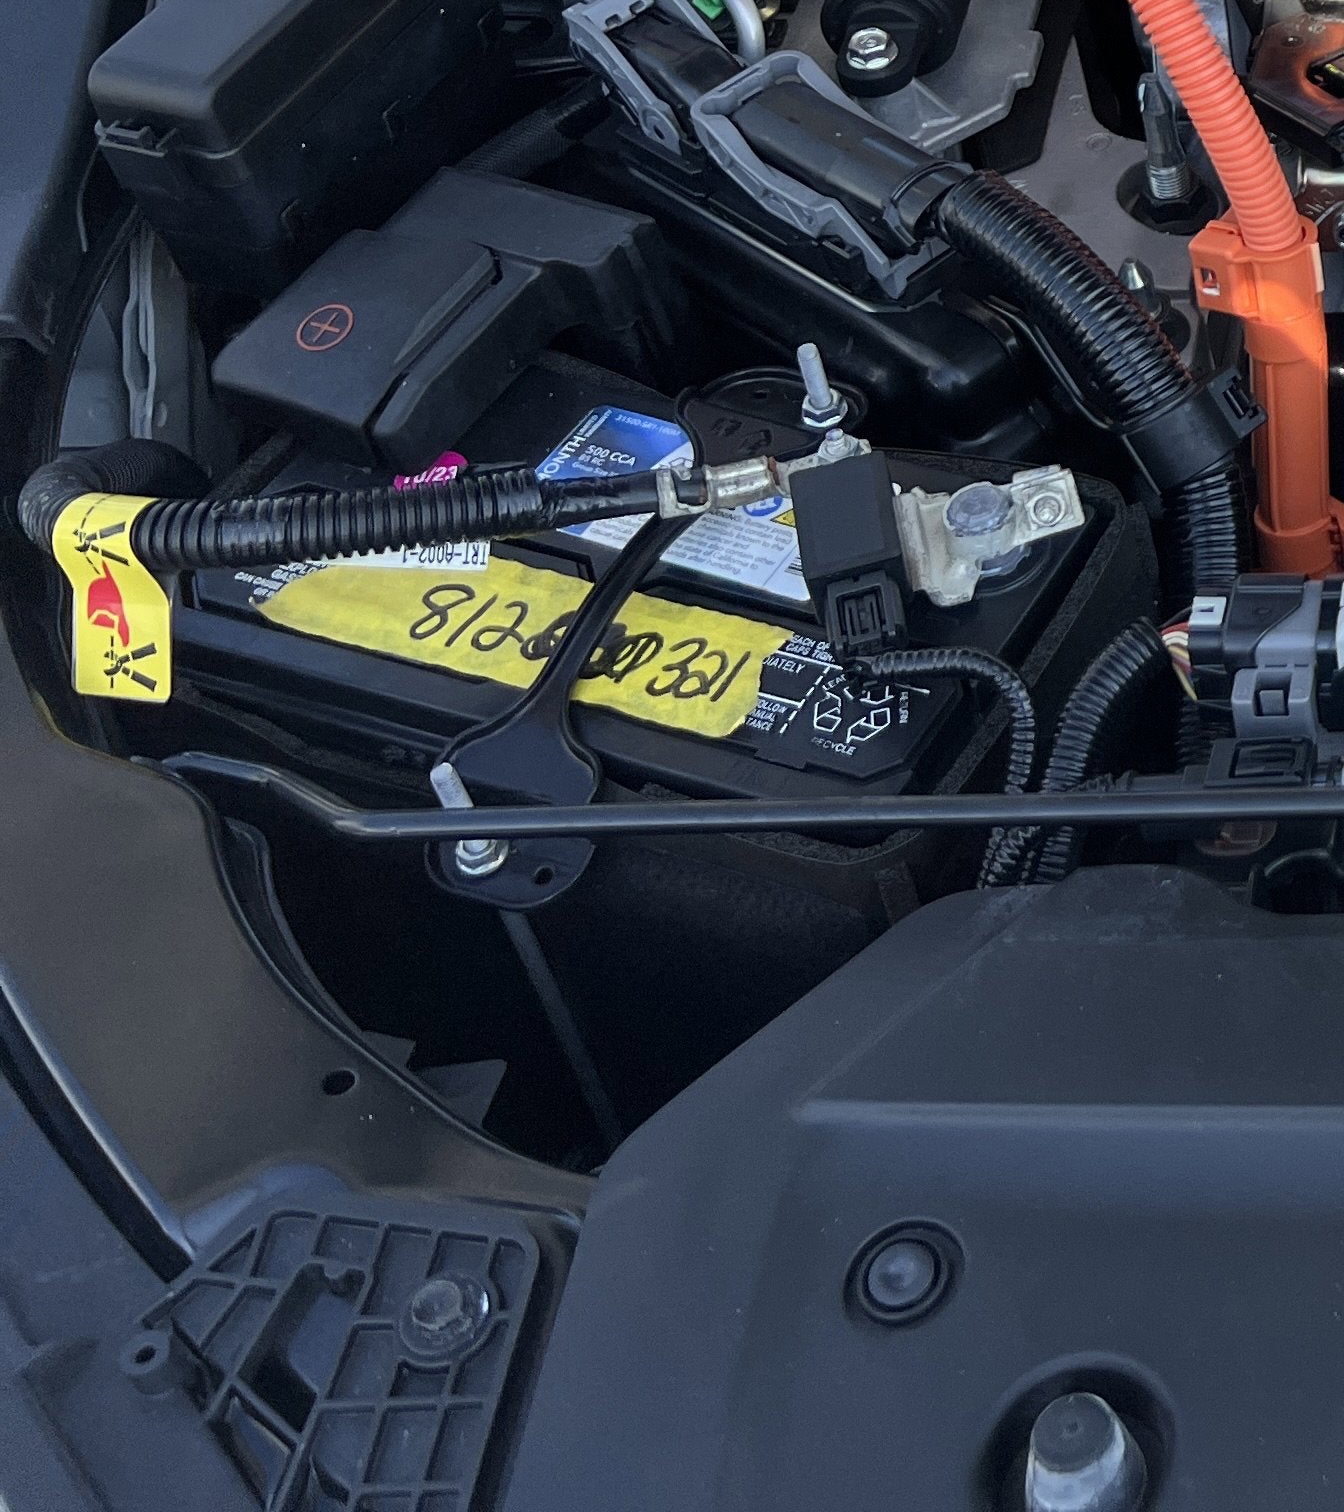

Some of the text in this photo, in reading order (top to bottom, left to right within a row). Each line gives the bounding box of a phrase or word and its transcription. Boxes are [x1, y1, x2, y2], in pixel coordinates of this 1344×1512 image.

[587, 444, 637, 467] 500 CCA
[786, 642, 810, 657] CAPS
[810, 737, 858, 756] RECYCLE
